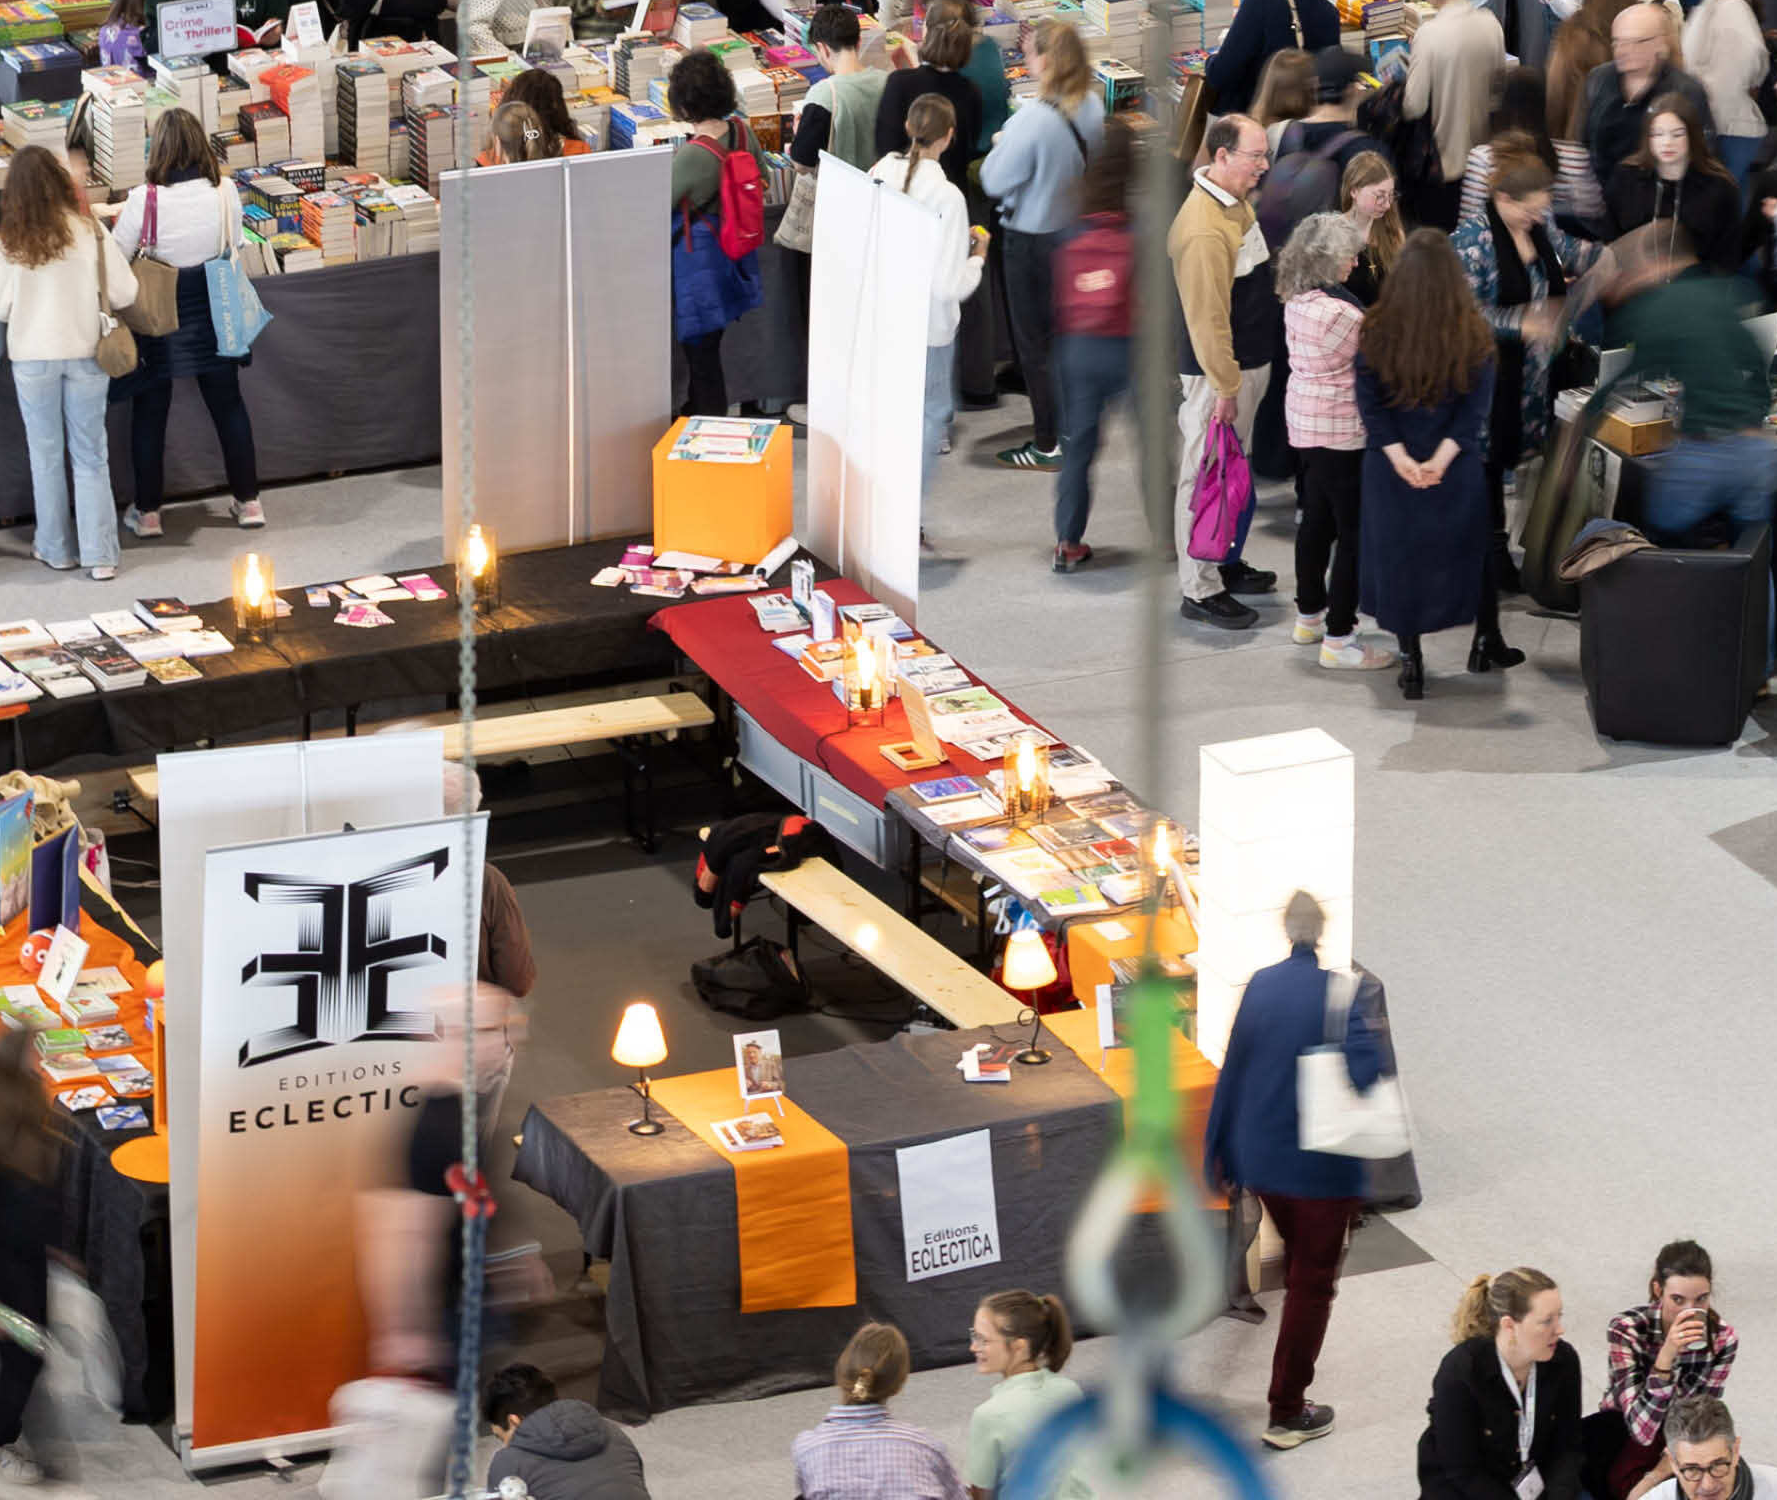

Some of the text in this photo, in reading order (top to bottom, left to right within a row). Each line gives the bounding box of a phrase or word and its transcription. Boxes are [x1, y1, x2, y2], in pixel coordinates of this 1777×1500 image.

[164, 17, 204, 32] Crime
[184, 24, 232, 41] Thrillers
[278, 1060, 402, 1091] EDITIONS
[229, 1085, 421, 1134] ECLECTIC
[924, 1224, 979, 1245] Editions
[911, 1233, 994, 1274] ECLECTICA
